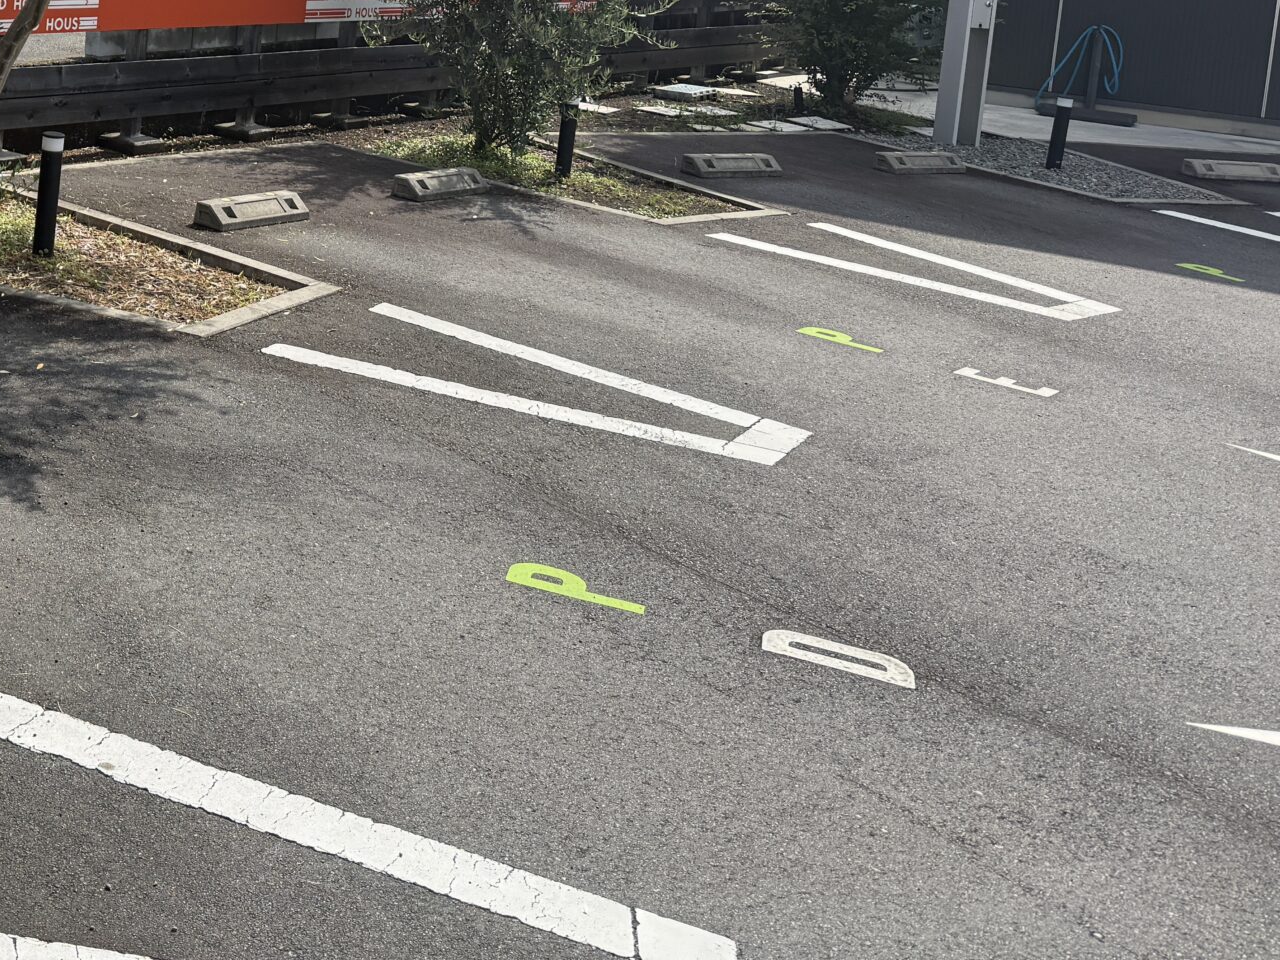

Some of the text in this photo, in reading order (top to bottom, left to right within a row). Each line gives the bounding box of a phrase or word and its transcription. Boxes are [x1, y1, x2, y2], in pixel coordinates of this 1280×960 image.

[795, 326, 884, 353] P
[953, 366, 1060, 398] E
[505, 562, 646, 615] P
